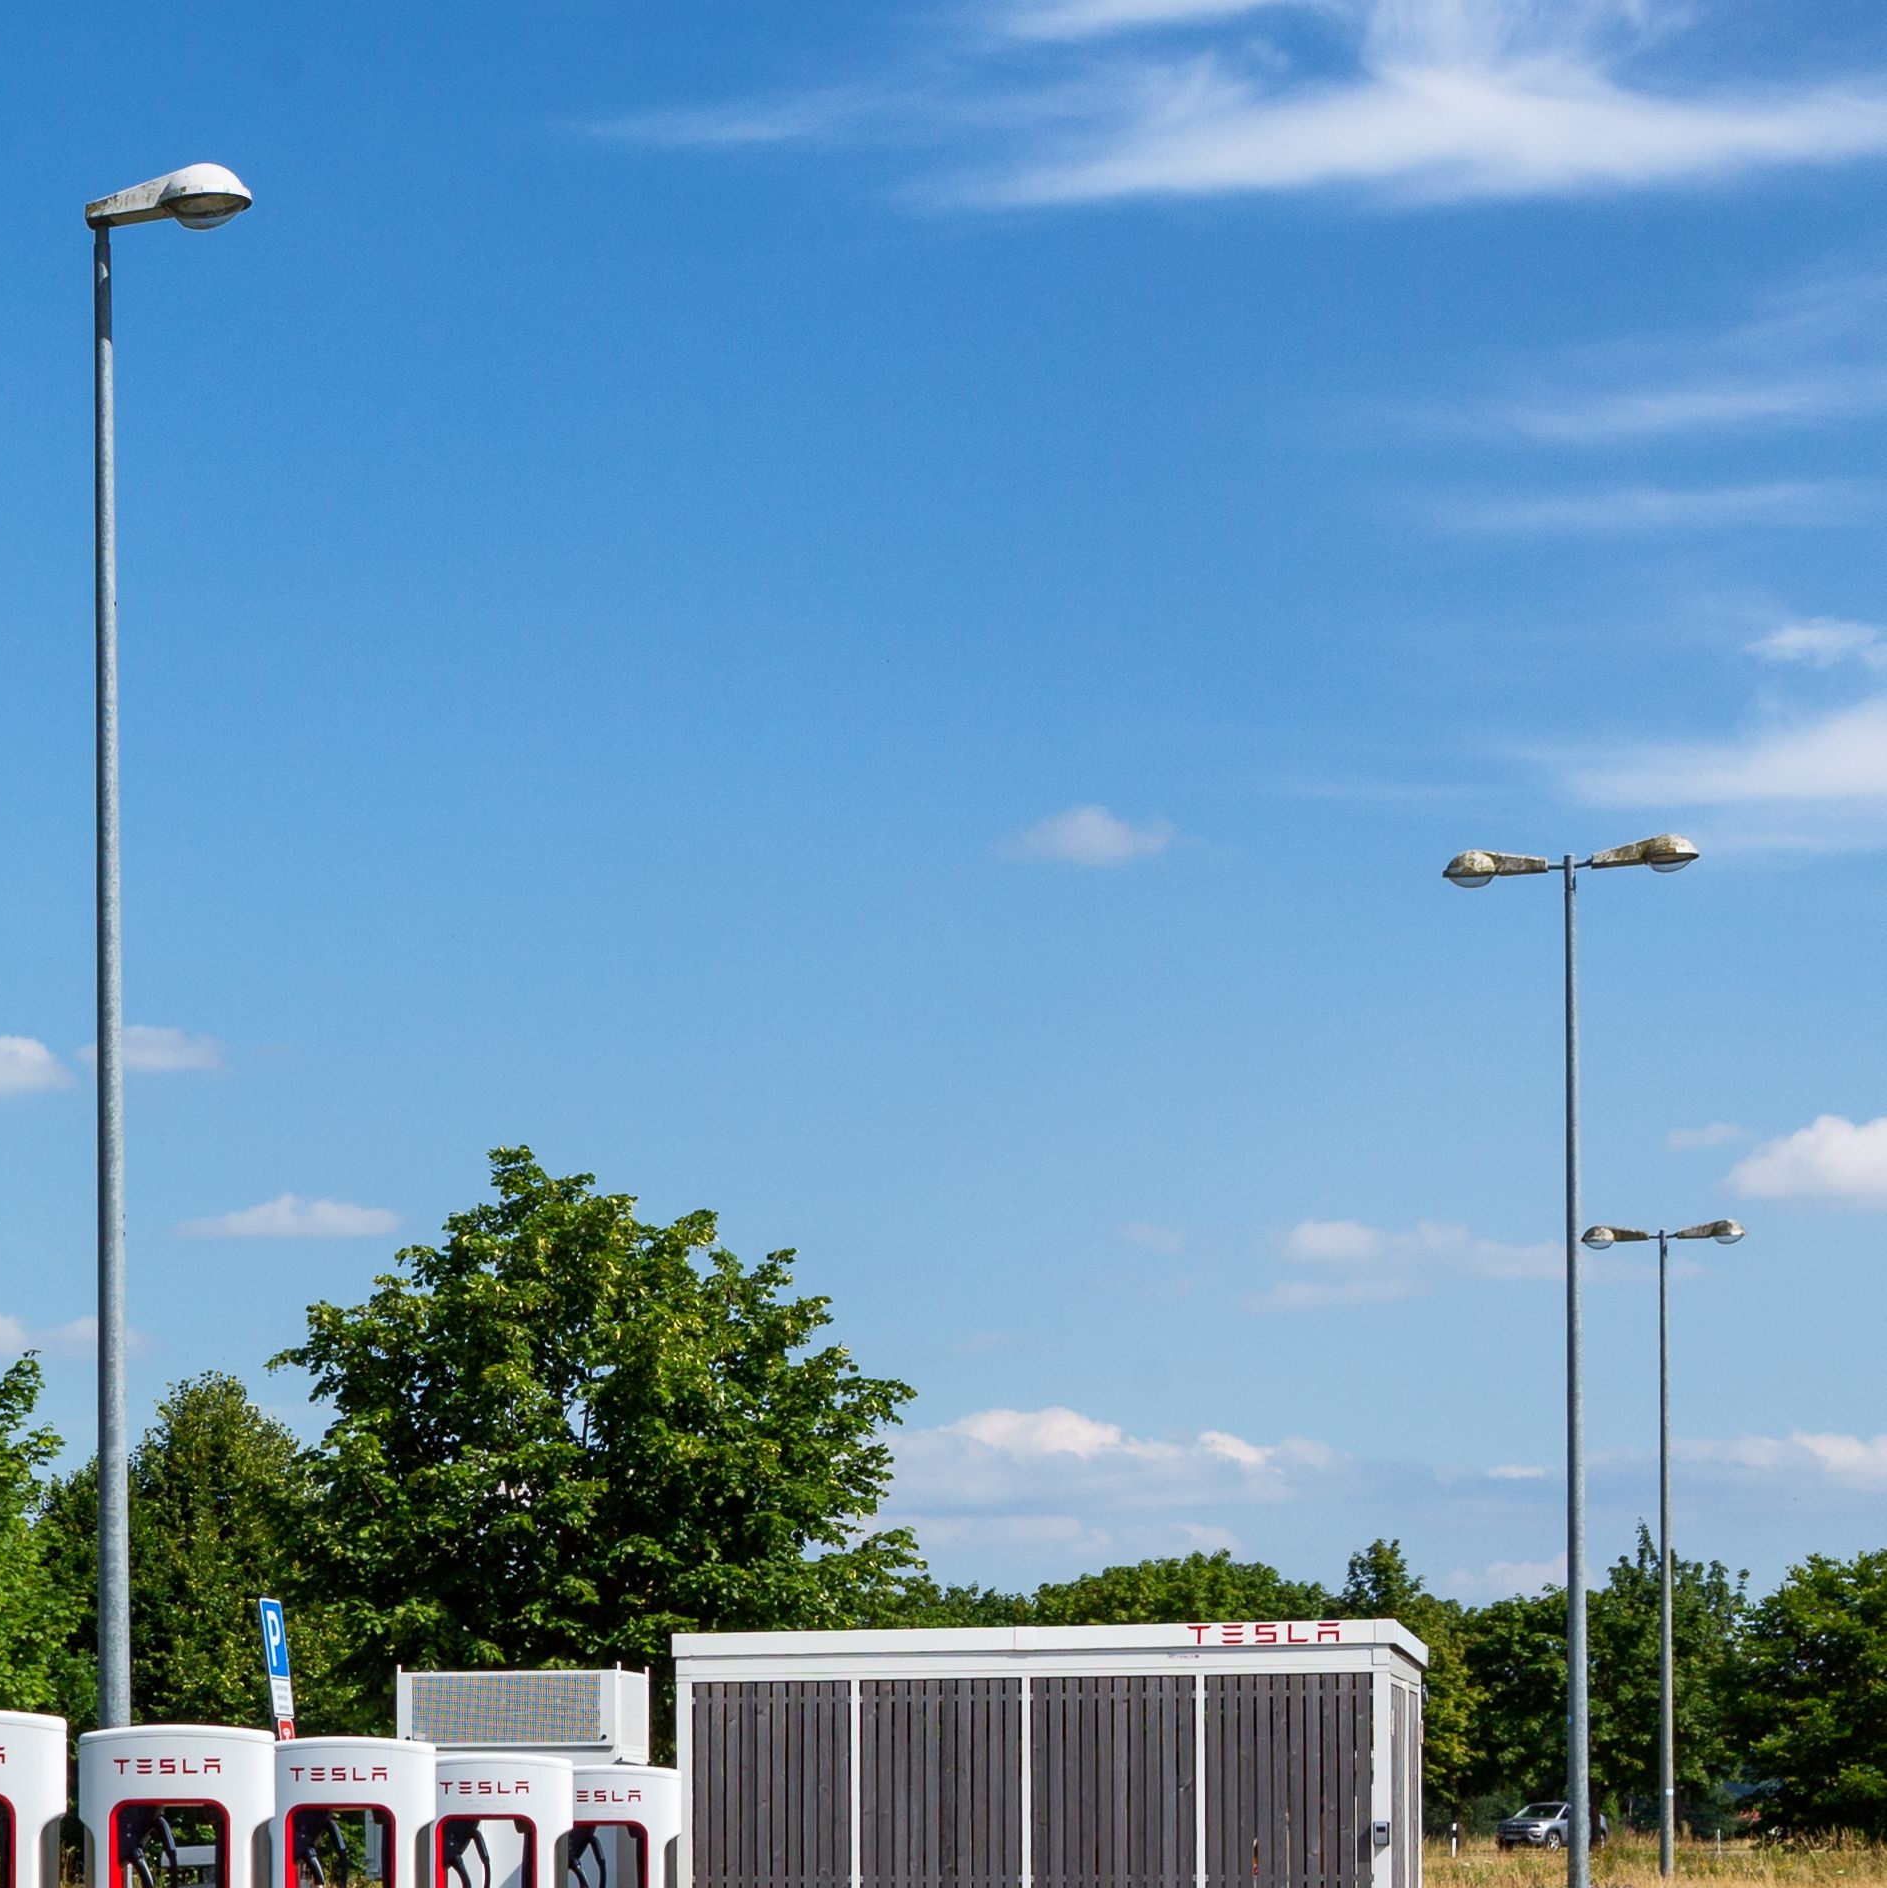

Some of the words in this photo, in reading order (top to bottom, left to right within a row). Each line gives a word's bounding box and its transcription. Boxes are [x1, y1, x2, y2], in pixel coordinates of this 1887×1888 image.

[266, 1610, 280, 1667] P
[1187, 1622, 1340, 1645] TESLA
[114, 1758, 222, 1775] TESLA
[290, 1767, 388, 1782] TESLA
[440, 1780, 529, 1795] TESLA
[576, 1790, 642, 1802] ESLA
